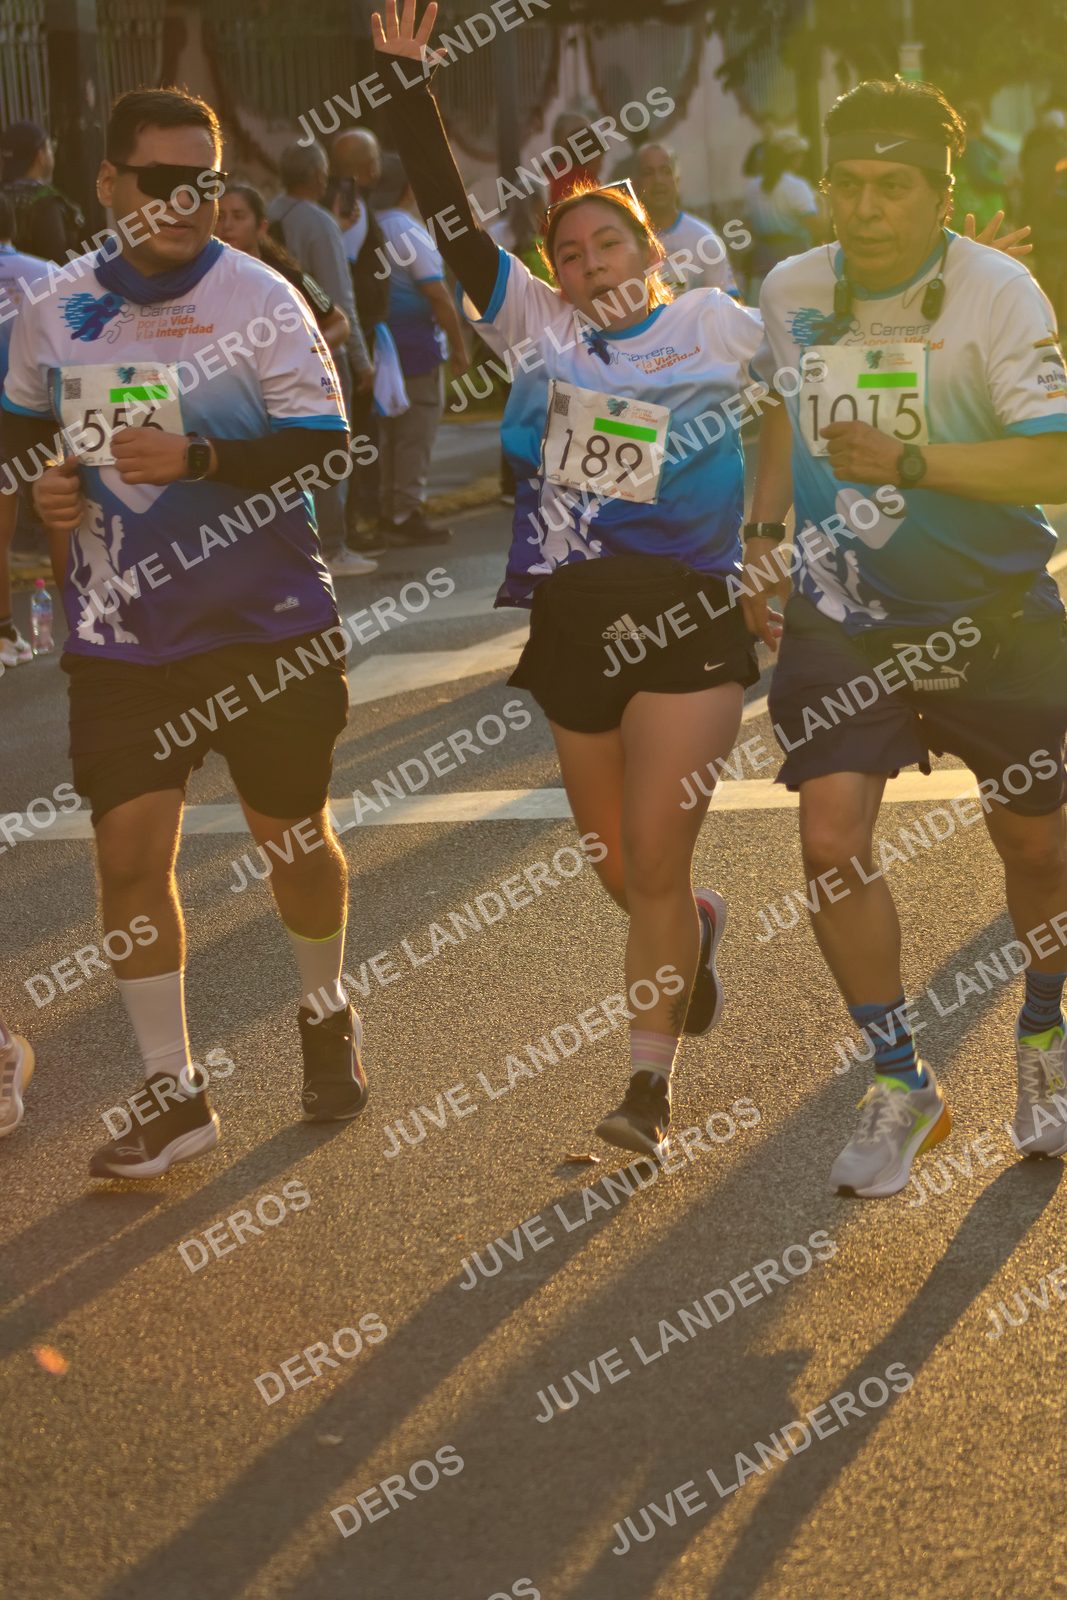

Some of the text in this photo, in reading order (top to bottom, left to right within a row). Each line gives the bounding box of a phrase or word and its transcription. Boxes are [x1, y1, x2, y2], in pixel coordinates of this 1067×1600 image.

[140, 304, 196, 318] Carrera
[170, 315, 194, 326] Vida
[156, 324, 214, 338] Integridad
[870, 322, 931, 336] Carrera
[808, 393, 922, 442] 1015
[559, 428, 643, 484] 189
[602, 630, 646, 640] adidas
[912, 676, 960, 692] PUMA
